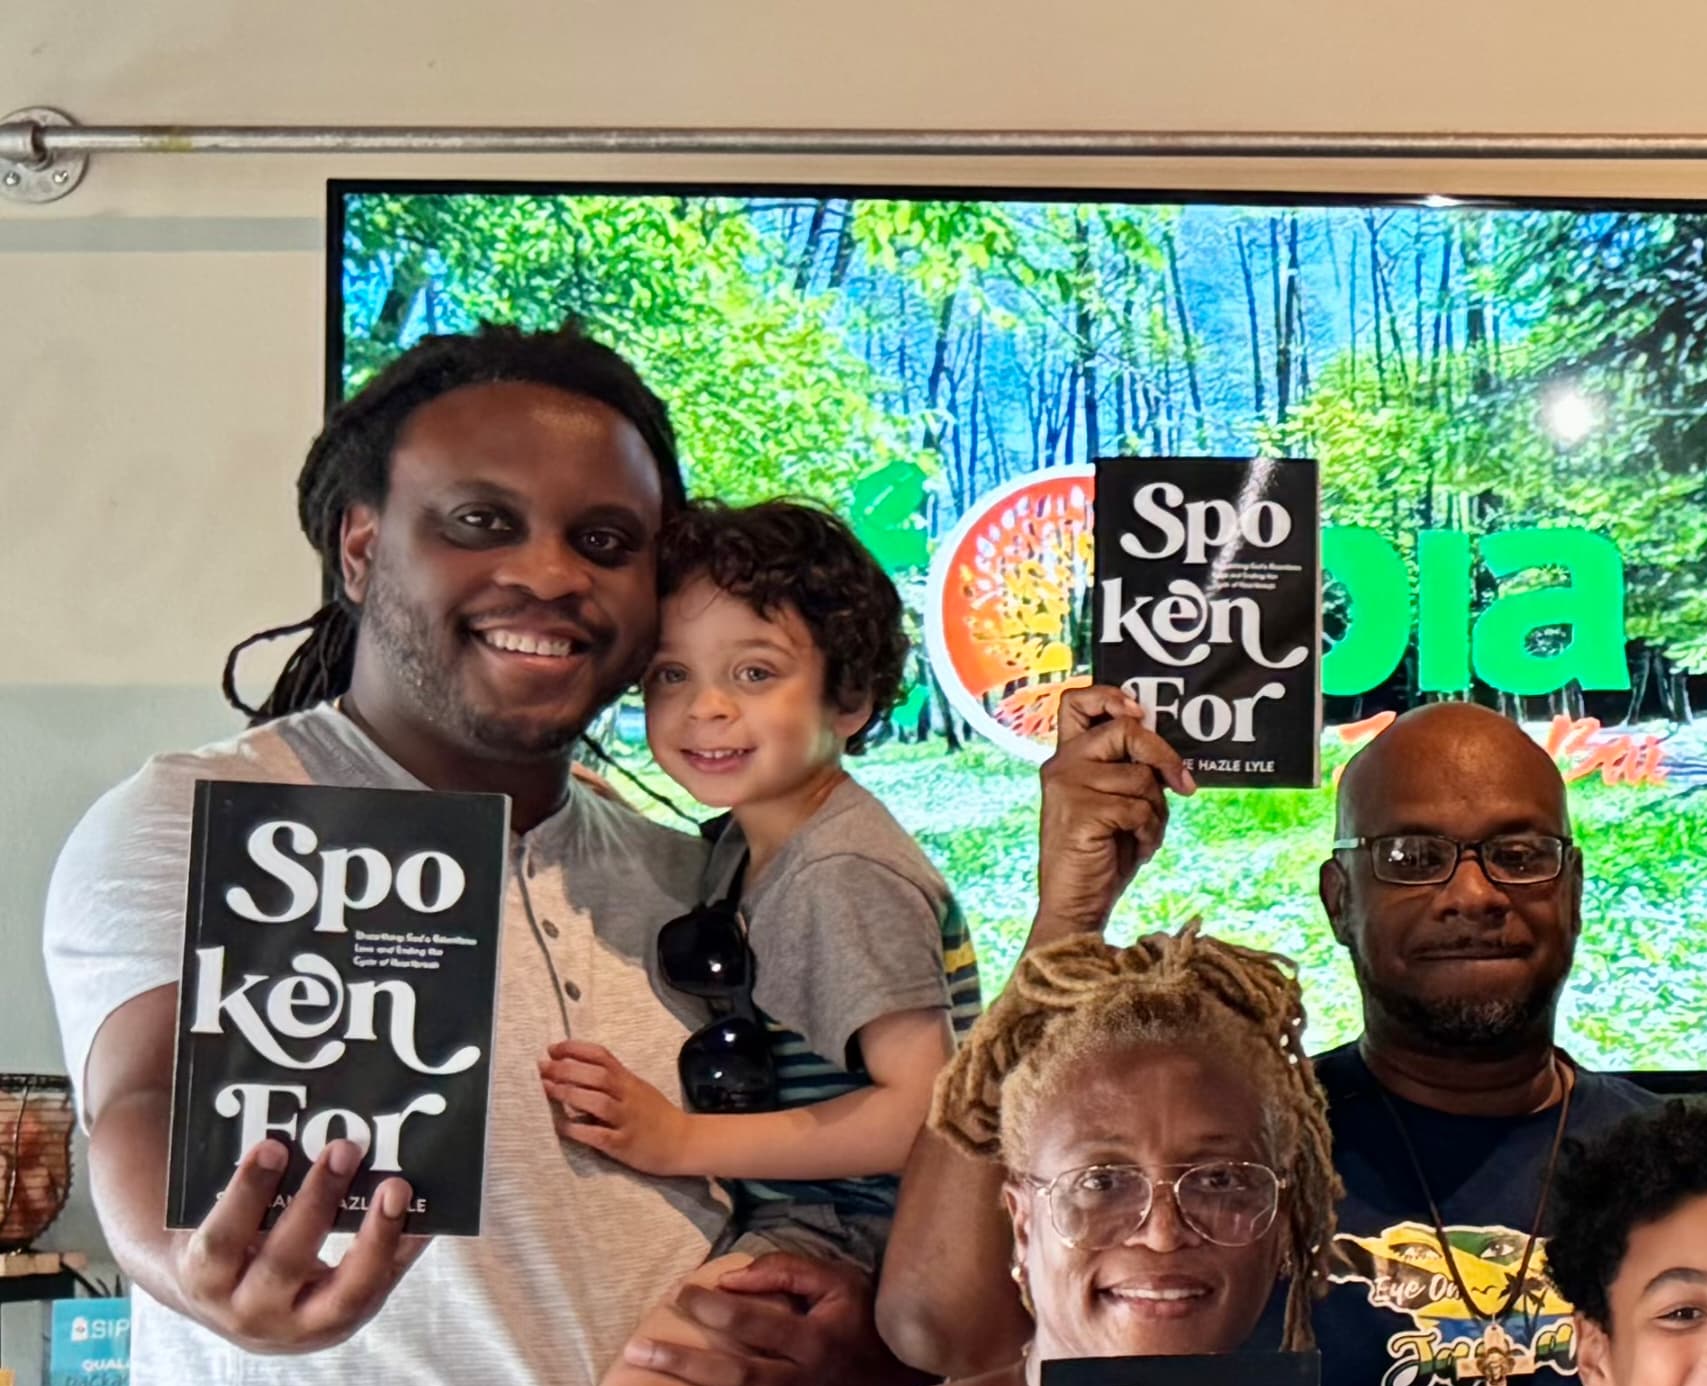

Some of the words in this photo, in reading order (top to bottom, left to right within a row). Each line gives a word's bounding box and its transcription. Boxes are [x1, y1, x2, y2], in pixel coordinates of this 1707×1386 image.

[1120, 482, 1291, 564] Spo
[1100, 577, 1308, 668] ken
[1121, 676, 1285, 742] For
[226, 820, 466, 932] Spo
[190, 946, 481, 1075] ken
[215, 1083, 447, 1172] For
[1373, 1276, 1426, 1308] Eye
[81, 1358, 130, 1373] QUAL
